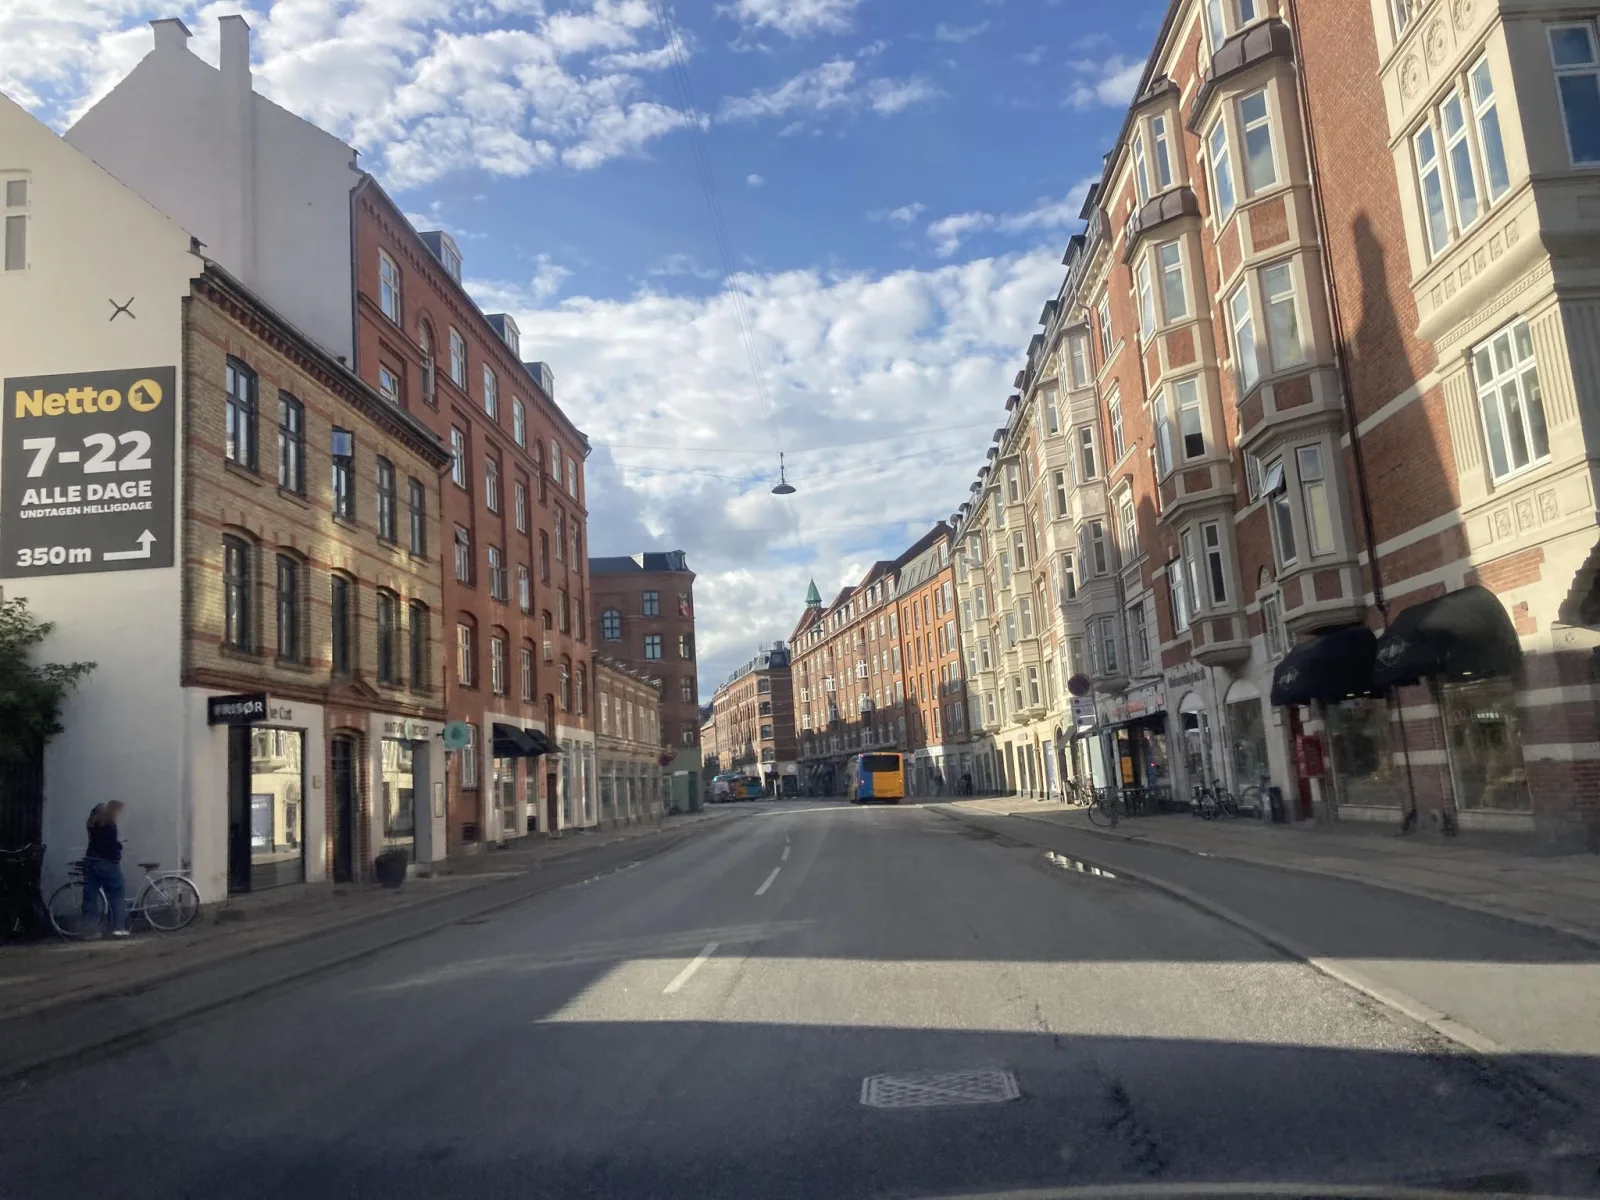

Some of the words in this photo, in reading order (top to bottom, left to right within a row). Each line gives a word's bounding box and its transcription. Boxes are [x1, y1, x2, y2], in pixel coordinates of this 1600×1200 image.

[15, 386, 122, 418] Netto
[23, 430, 152, 478] 7-22
[21, 486, 81, 506] ALLE
[87, 480, 152, 501] DAGE
[20, 507, 81, 518] UNDTAGEN
[83, 501, 152, 514] HELLIGDAGE
